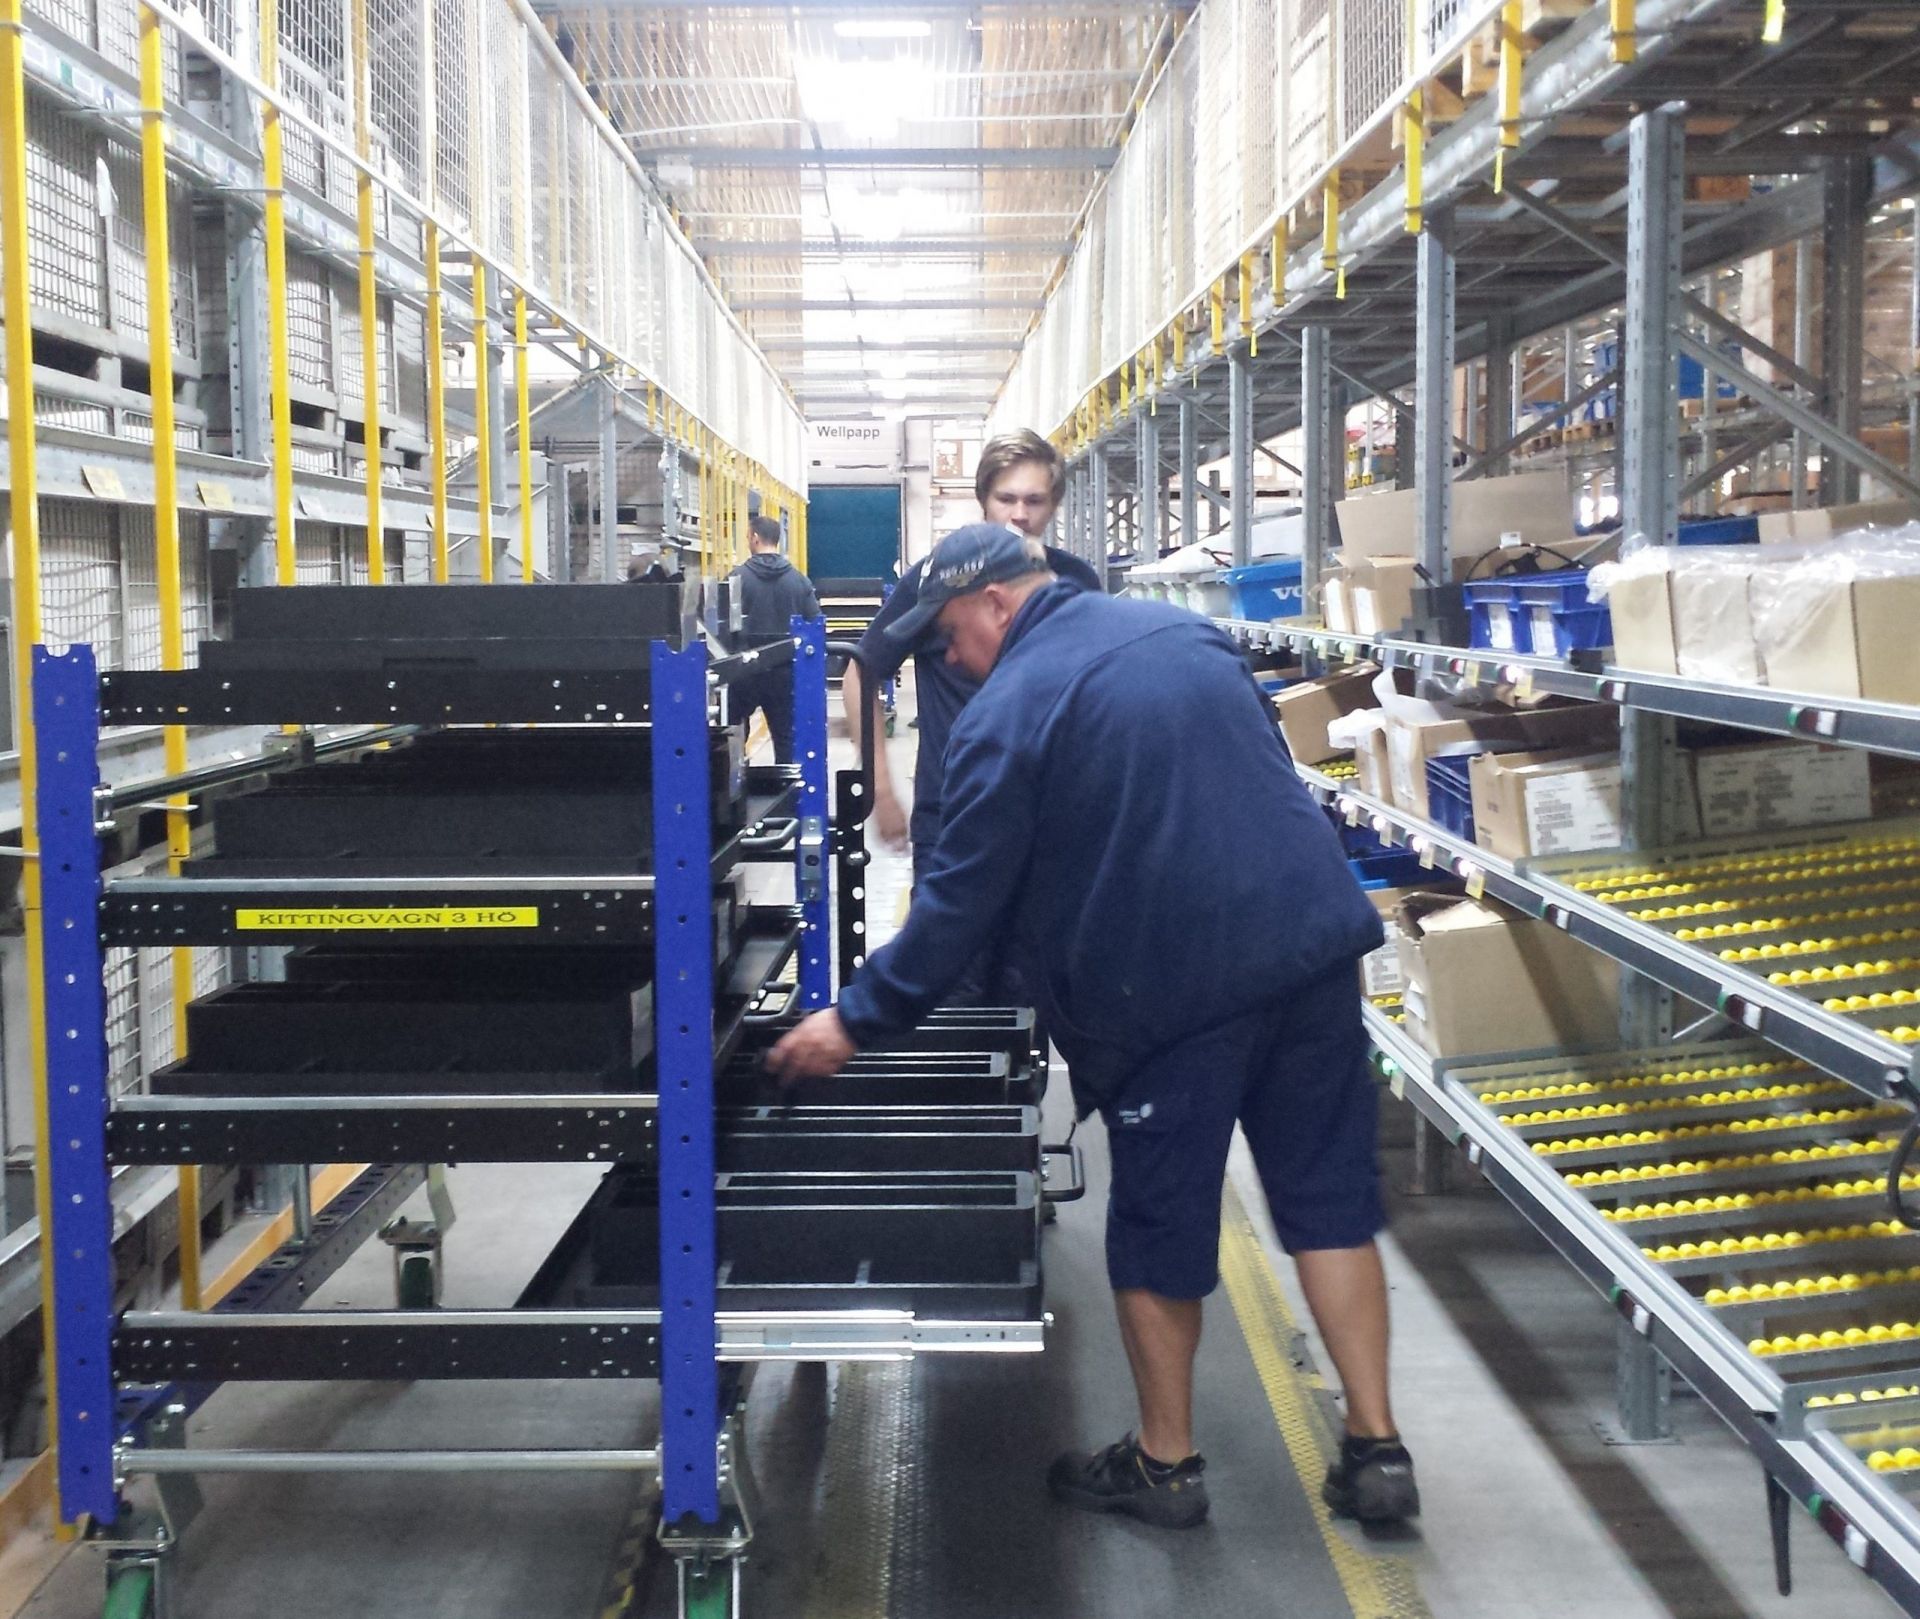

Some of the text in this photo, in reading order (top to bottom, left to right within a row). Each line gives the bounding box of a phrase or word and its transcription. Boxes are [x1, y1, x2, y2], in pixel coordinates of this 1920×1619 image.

[816, 426, 880, 440] Wellpapp
[258, 909, 517, 925] KITTINGVAGN 3 HÖ
